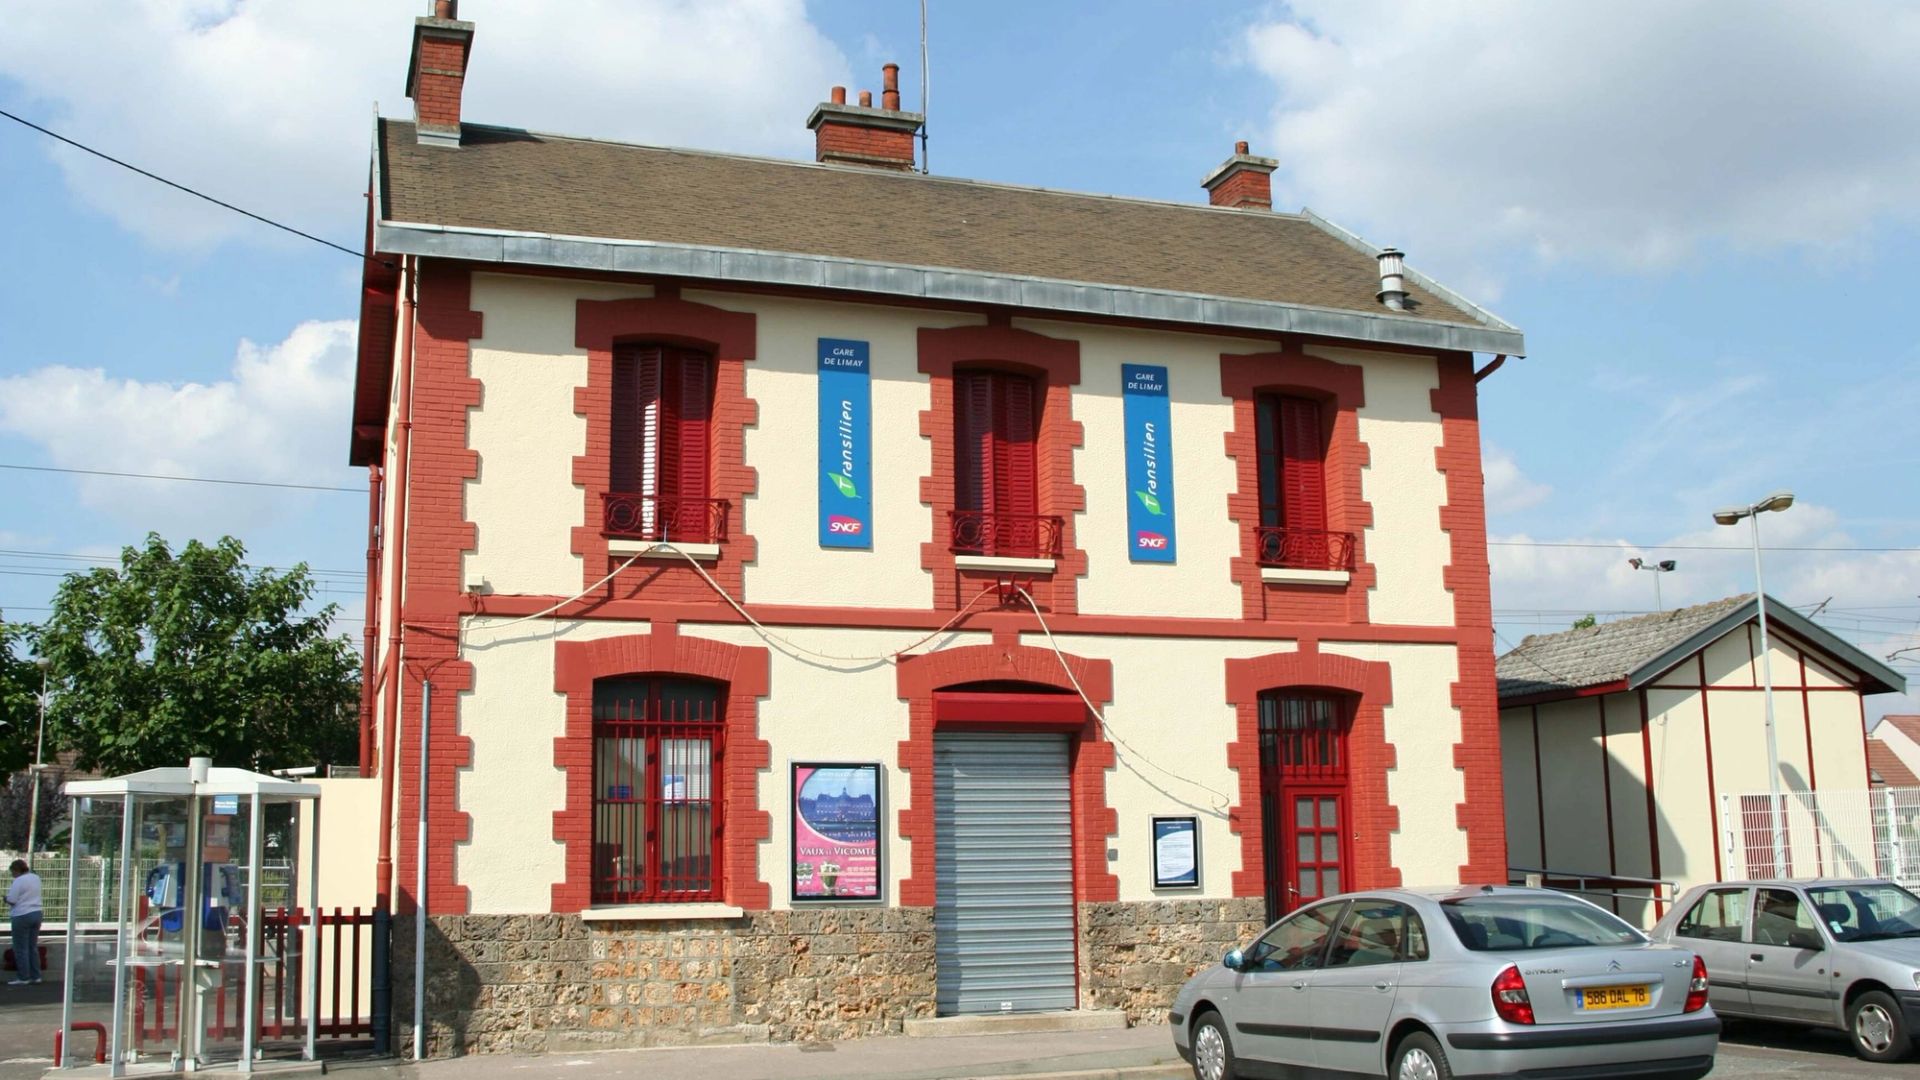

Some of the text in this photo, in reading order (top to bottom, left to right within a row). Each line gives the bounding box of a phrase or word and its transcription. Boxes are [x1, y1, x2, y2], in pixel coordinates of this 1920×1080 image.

[833, 348, 855, 356] GARE
[824, 357, 863, 367] DE LIMAY
[1135, 372, 1155, 381] GARE
[1127, 382, 1163, 391] DE LIMAY
[839, 400, 852, 489] Transilien
[1143, 422, 1157, 507] Transilien
[830, 521, 861, 532] SNCF
[1138, 537, 1167, 547] SNCF
[800, 847, 824, 856] VAUX
[834, 847, 876, 856] VICOMTE
[1587, 987, 1646, 1005] 586 DAL 78
